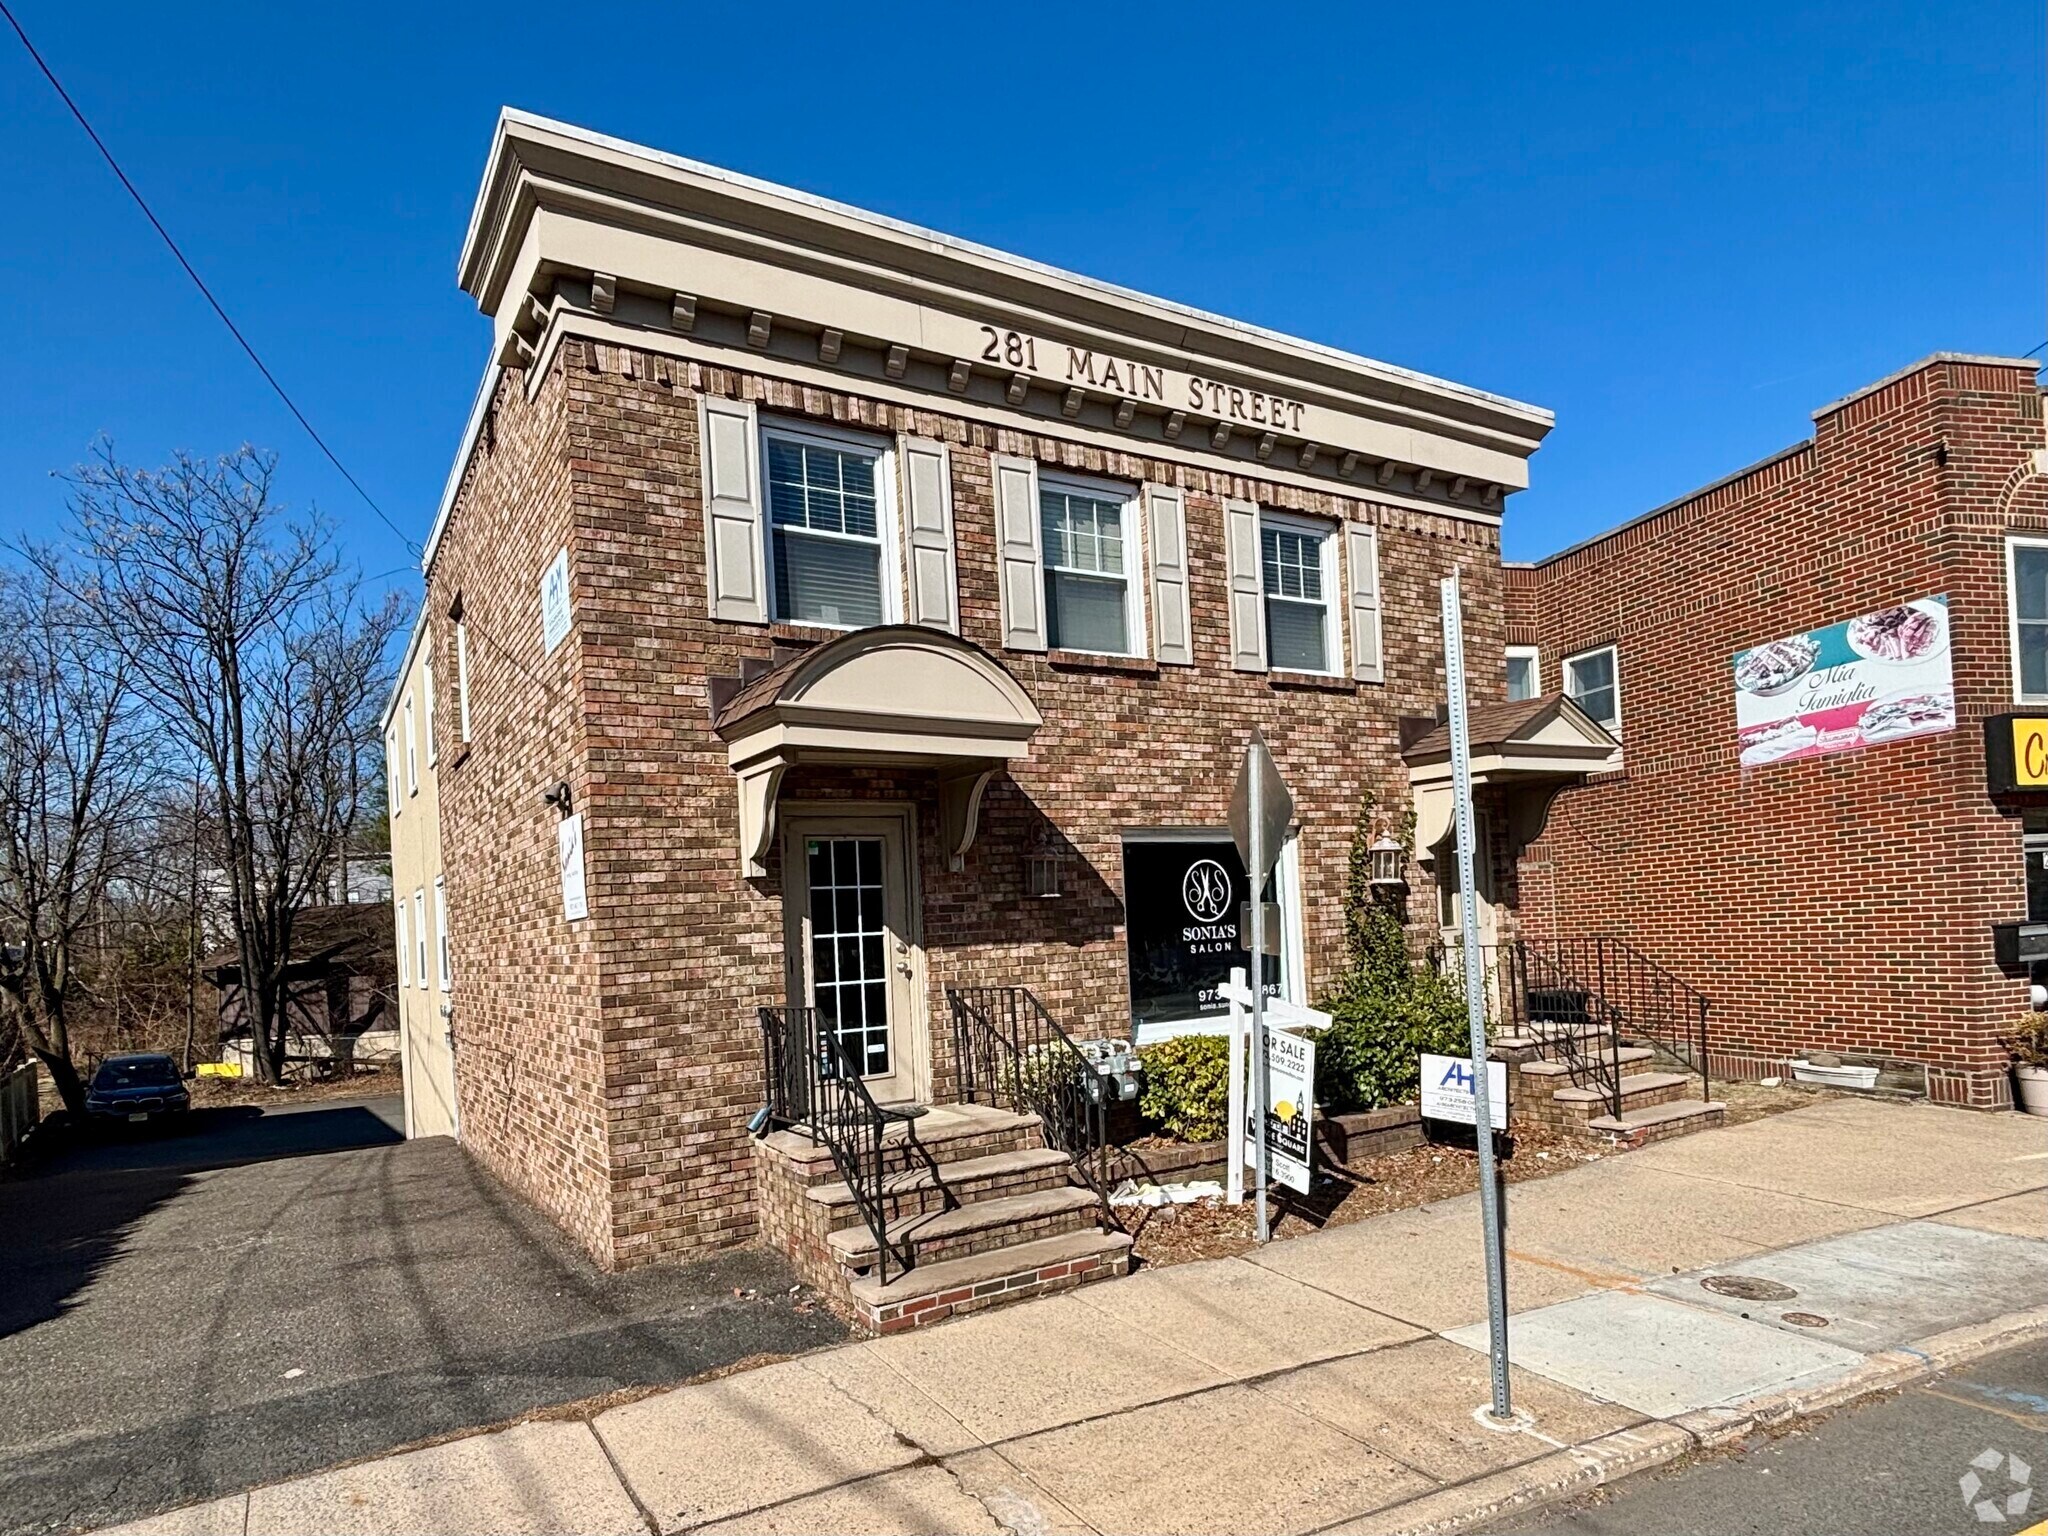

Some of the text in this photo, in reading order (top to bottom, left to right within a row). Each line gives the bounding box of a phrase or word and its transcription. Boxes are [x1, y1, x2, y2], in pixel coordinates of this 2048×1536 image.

[980, 326, 1305, 432] 281 MAIN STREET
[1809, 664, 1856, 689] Mia
[2025, 732, 2048, 778] C
[1182, 924, 1237, 942] SONIA'S
[1190, 942, 1232, 954] SALON
[1280, 1040, 1306, 1061] SALE
